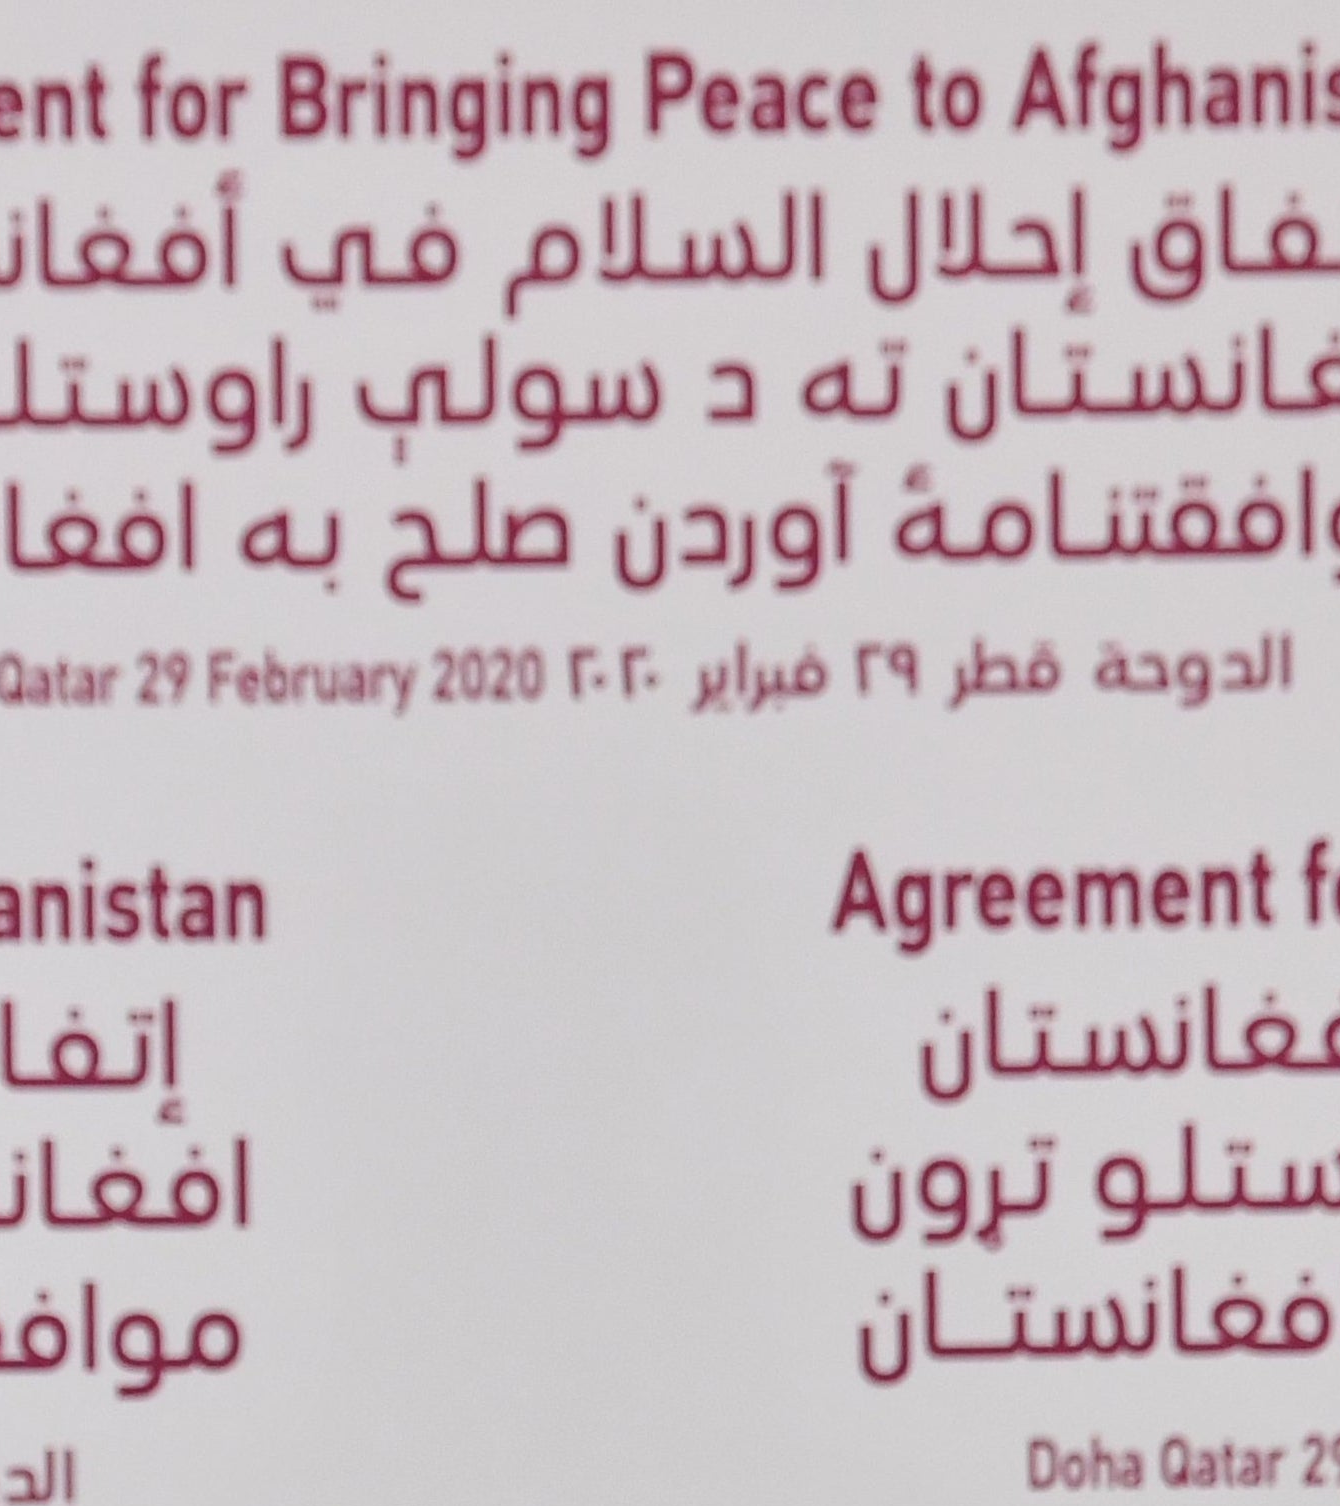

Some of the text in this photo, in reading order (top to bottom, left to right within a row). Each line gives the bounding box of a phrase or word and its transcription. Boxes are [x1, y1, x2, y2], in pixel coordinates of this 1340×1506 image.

[137, 52, 252, 143] for
[278, 51, 613, 164] Bringing
[645, 45, 882, 137] Peace
[912, 55, 986, 134] to
[281, 203, 462, 311] في
[502, 187, 826, 319] السلام
[868, 185, 1093, 313] إحلال
[709, 360, 758, 424] د
[802, 340, 909, 421] ته
[240, 508, 342, 590] به
[386, 476, 573, 606] صلح
[614, 460, 854, 592] آوردن
[141, 651, 191, 705] 29
[209, 649, 416, 709] February
[435, 647, 544, 701] 2020
[696, 642, 830, 713] فبراير
[951, 639, 1062, 707] قطر
[1096, 634, 1294, 708] الدوحة
[833, 849, 1276, 956] Agreement
[1029, 1438, 1145, 1490] Doha
[1161, 1435, 1283, 1488] Qatar
